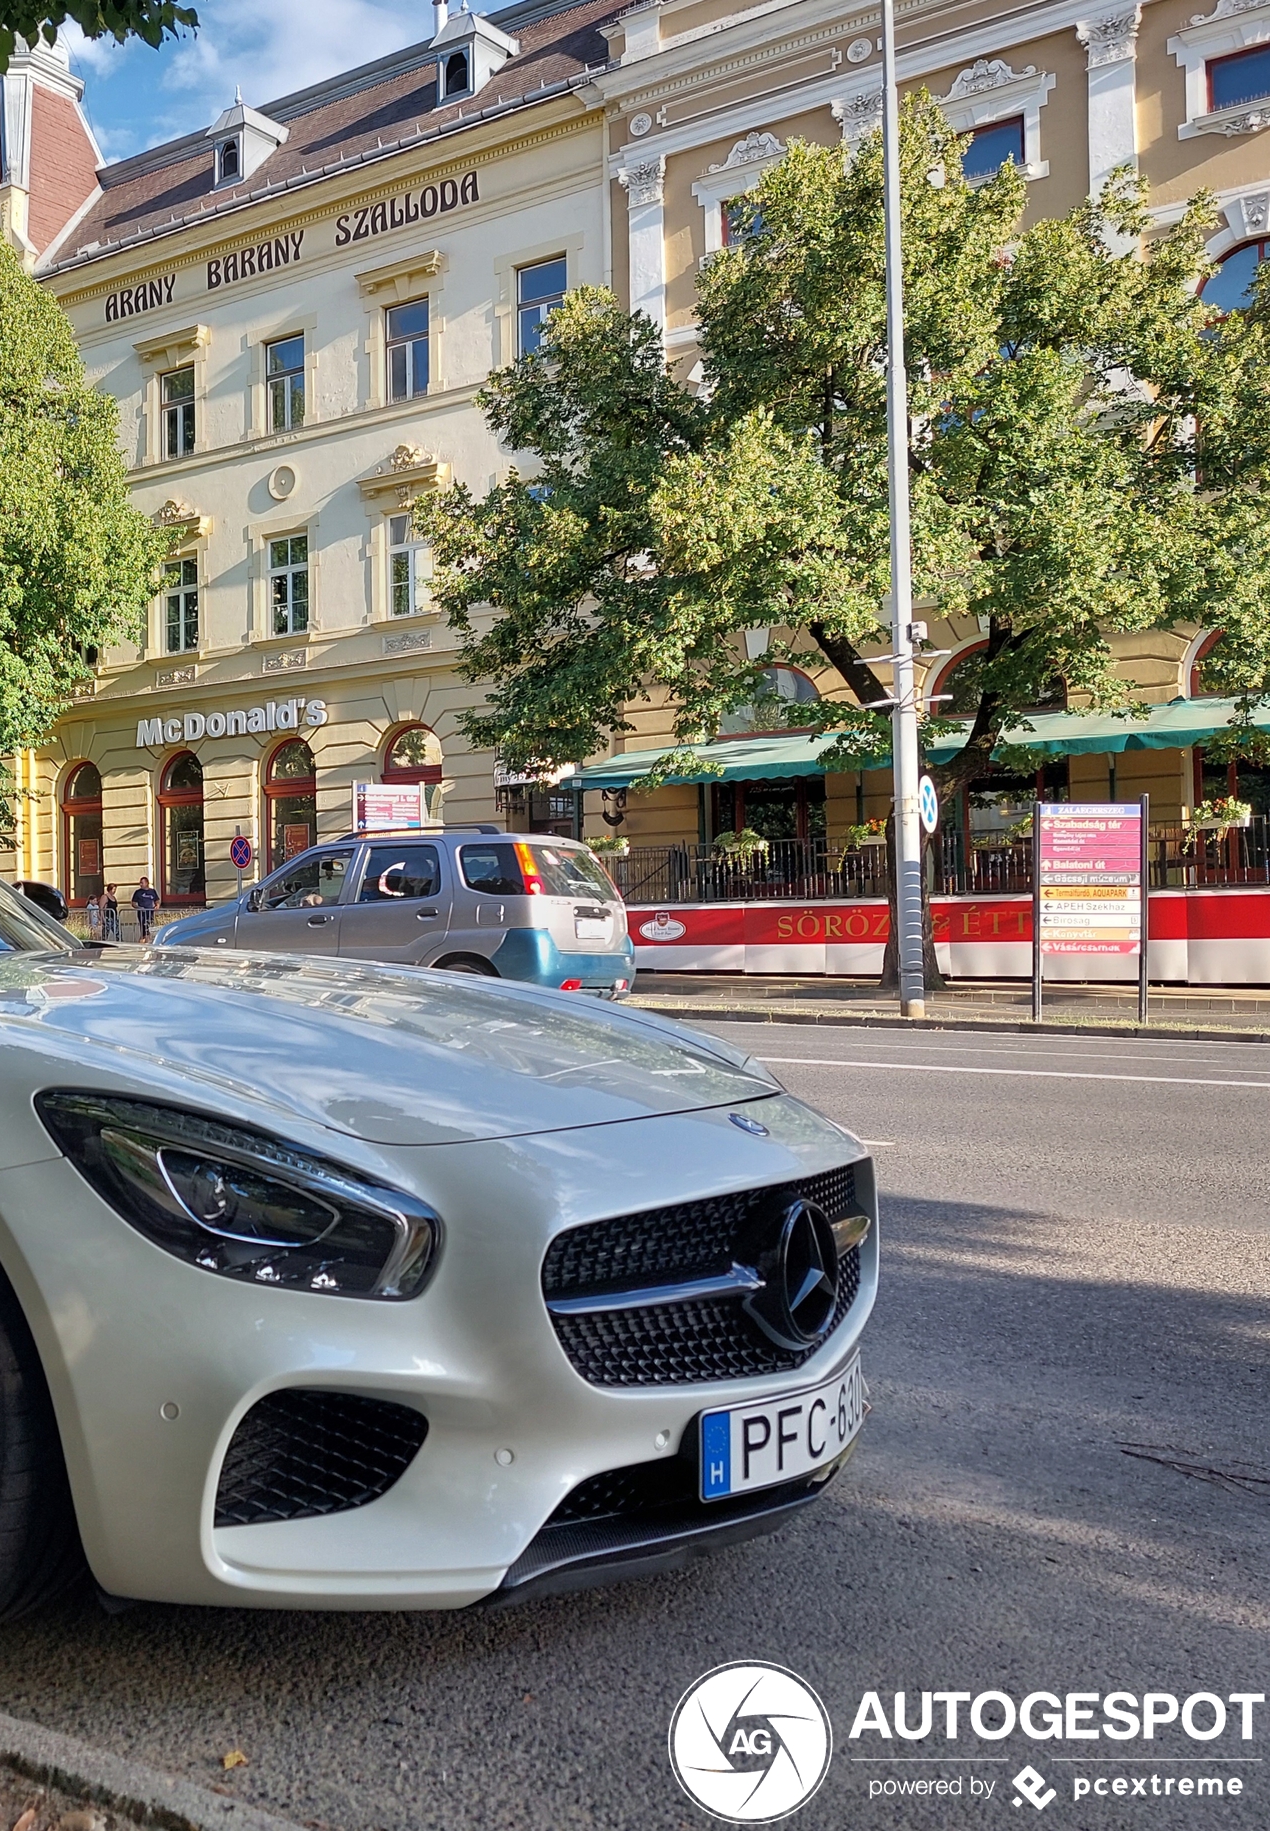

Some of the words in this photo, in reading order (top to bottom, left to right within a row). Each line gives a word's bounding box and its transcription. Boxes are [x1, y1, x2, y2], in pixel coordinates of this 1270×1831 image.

[105, 274, 176, 323] ARANY
[136, 699, 329, 748] McDonald's
[1053, 820, 1106, 831] Szabadság
[1108, 821, 1122, 829] tér
[1053, 861, 1093, 869] Balatoni
[1095, 861, 1106, 869] út
[1089, 874, 1128, 883] múzeum
[1092, 889, 1127, 897] AQUAPARK
[1056, 902, 1084, 911] APEH
[1052, 929, 1097, 940] Könyvtár
[1053, 942, 1121, 952] Vásárcsarnok
[710, 1460, 724, 1485] H
[742, 1364, 863, 1480] PFC-630
